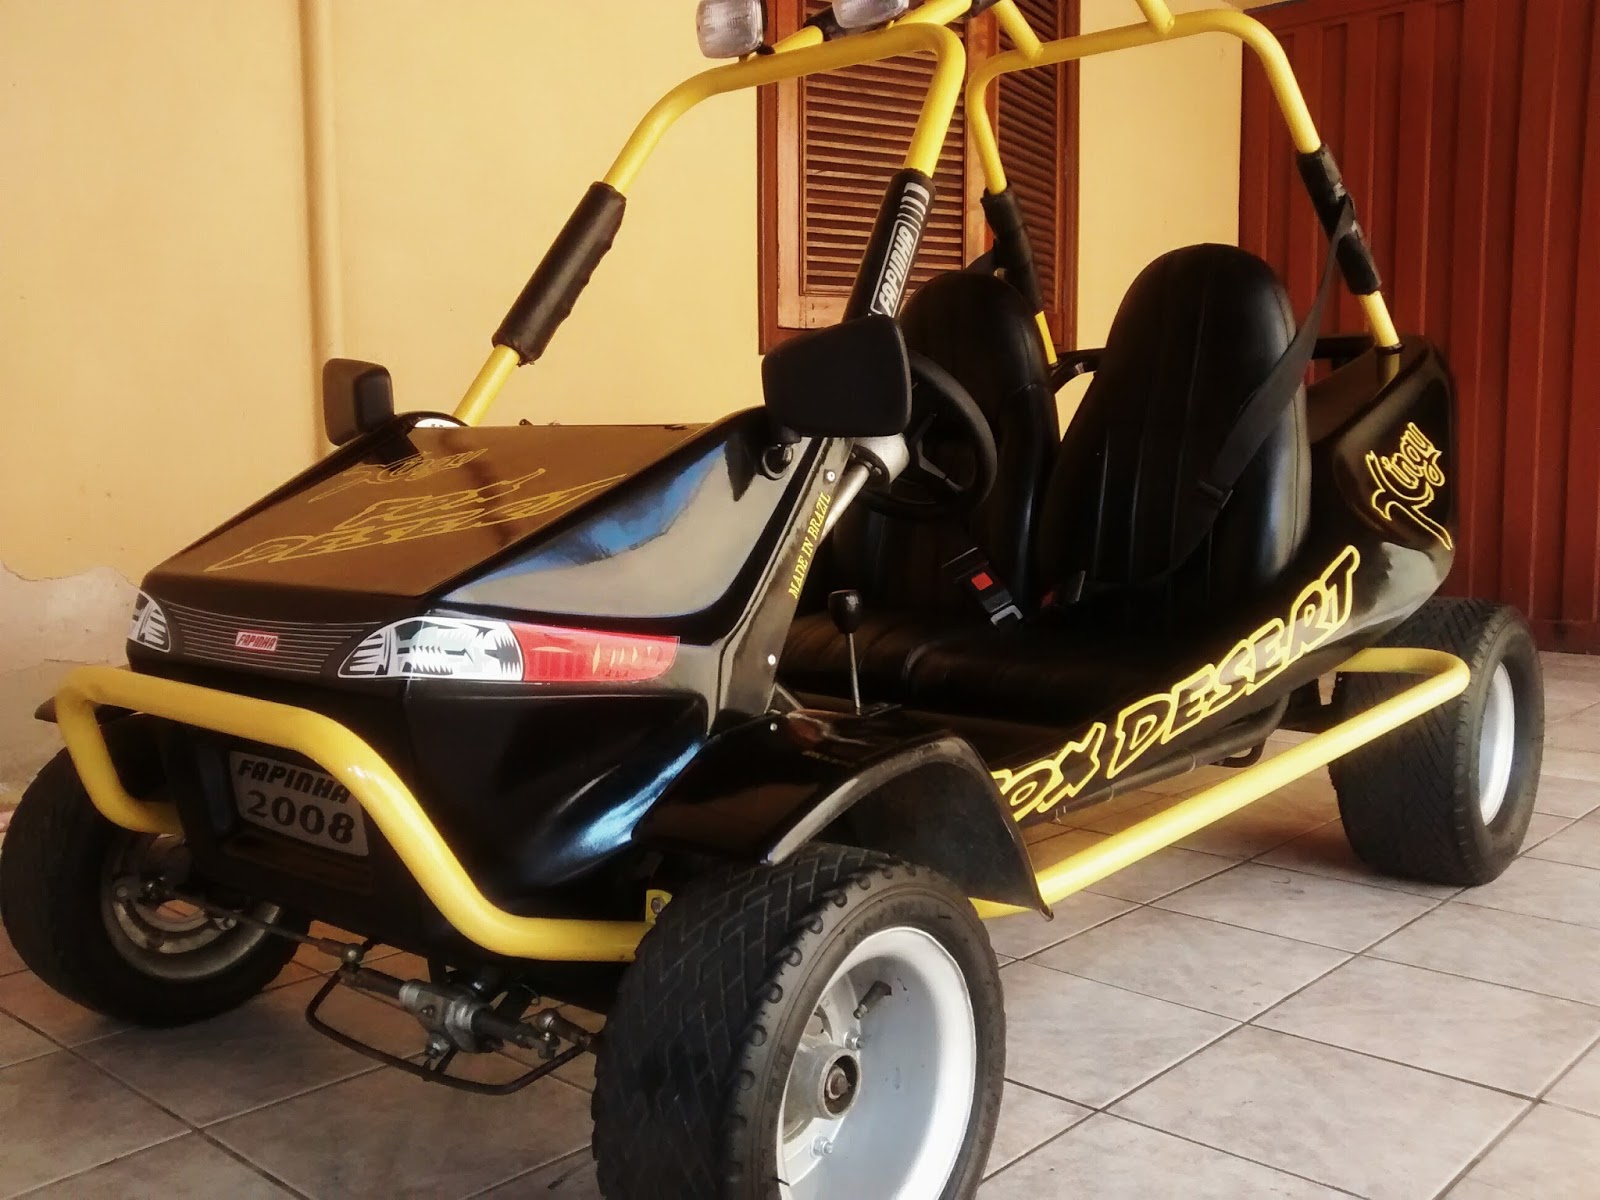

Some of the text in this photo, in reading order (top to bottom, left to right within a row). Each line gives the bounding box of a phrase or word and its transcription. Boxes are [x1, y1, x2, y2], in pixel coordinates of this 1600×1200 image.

[878, 225, 915, 317] FAPINHA
[203, 474, 628, 572] DESERT
[333, 468, 547, 531] FOX
[788, 491, 831, 599] MADE IN BRAZIL
[236, 633, 277, 650] FAPINHA
[1106, 544, 1361, 780] DESERT
[238, 759, 352, 804] FAPINHA
[247, 790, 355, 844] 2008
